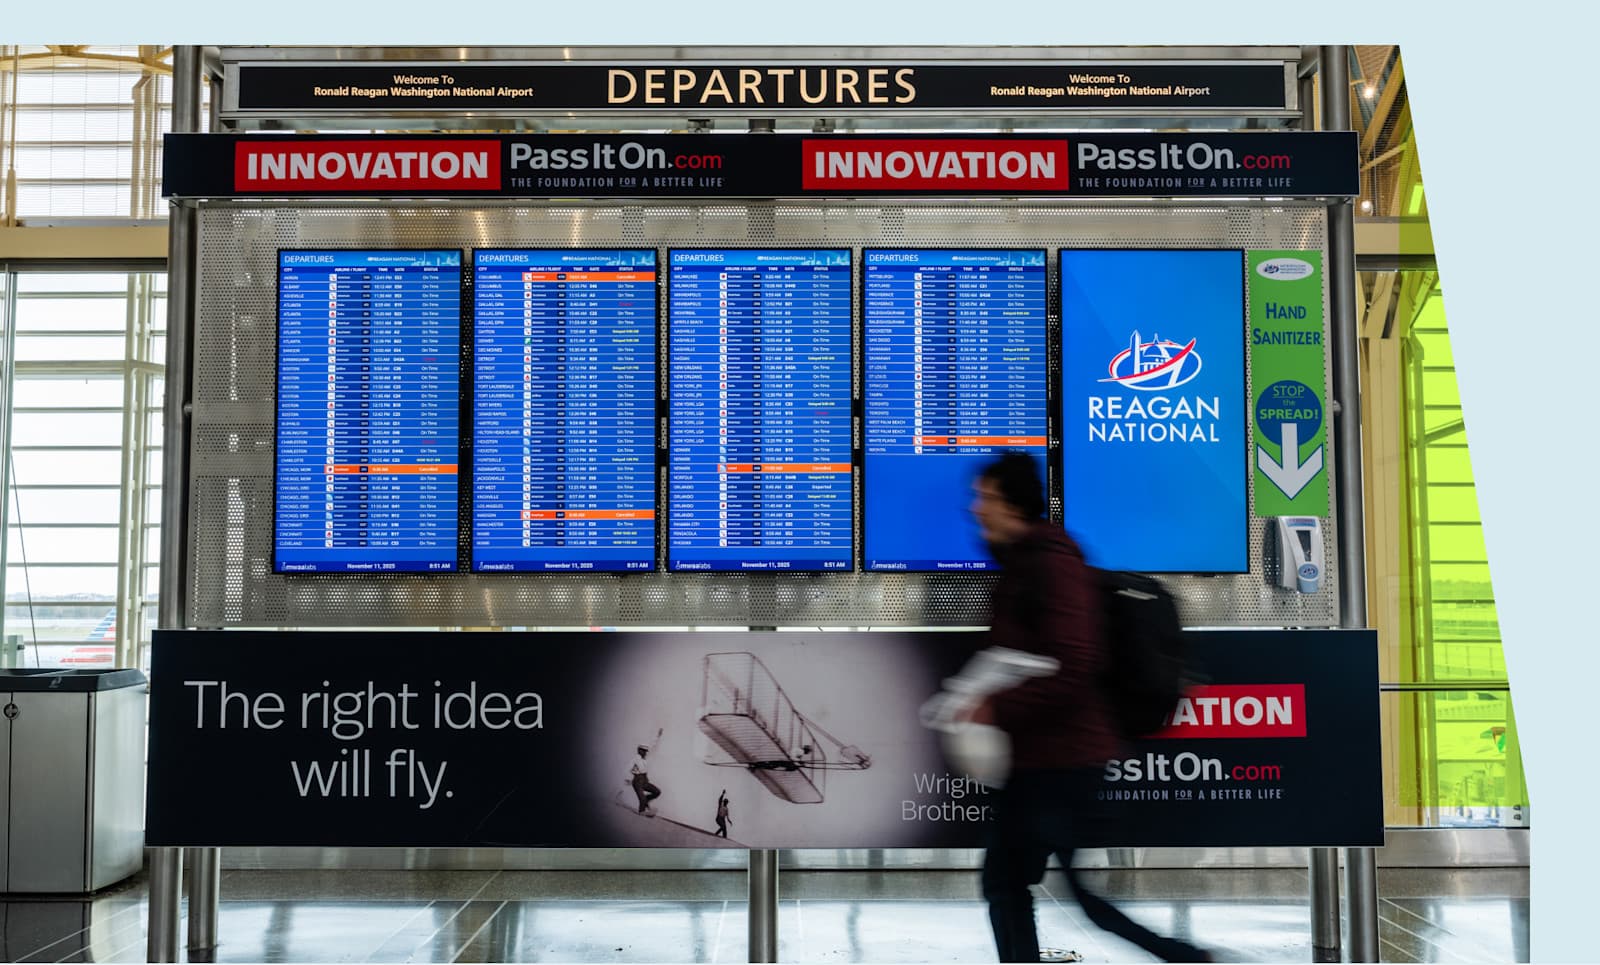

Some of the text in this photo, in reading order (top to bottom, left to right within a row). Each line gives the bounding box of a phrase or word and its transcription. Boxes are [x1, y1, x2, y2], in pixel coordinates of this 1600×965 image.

[394, 75, 454, 84] Welcome To
[608, 69, 915, 103] DEPARTURES
[1069, 74, 1130, 83] Welcome To
[315, 87, 533, 98] Ronald Reagan Washington National Airport
[991, 86, 1210, 97] Ronald Reagan Washington National Airport
[248, 152, 488, 179] INNOVATION
[816, 151, 1055, 179] INNOVATION
[511, 177, 722, 187] THE FOUNDATION FOR A BETTER LIFE
[1079, 178, 1290, 187] THE FOUNDATION FOR A BETTER LIFE
[1266, 303, 1306, 319] HAND
[1253, 328, 1320, 344] SANITIZER
[1273, 386, 1304, 397] STOP
[1089, 396, 1219, 419] REAGAN
[1260, 409, 1318, 419] SPREAD!
[1089, 423, 1219, 442] NATIONAL
[184, 680, 543, 740] The right idea
[1162, 696, 1293, 727] ATION
[1104, 752, 1281, 782] ssItOn.com
[291, 749, 453, 808] will fly.
[1097, 788, 1281, 800] OUNDATION FOR A BETTER LIFE
